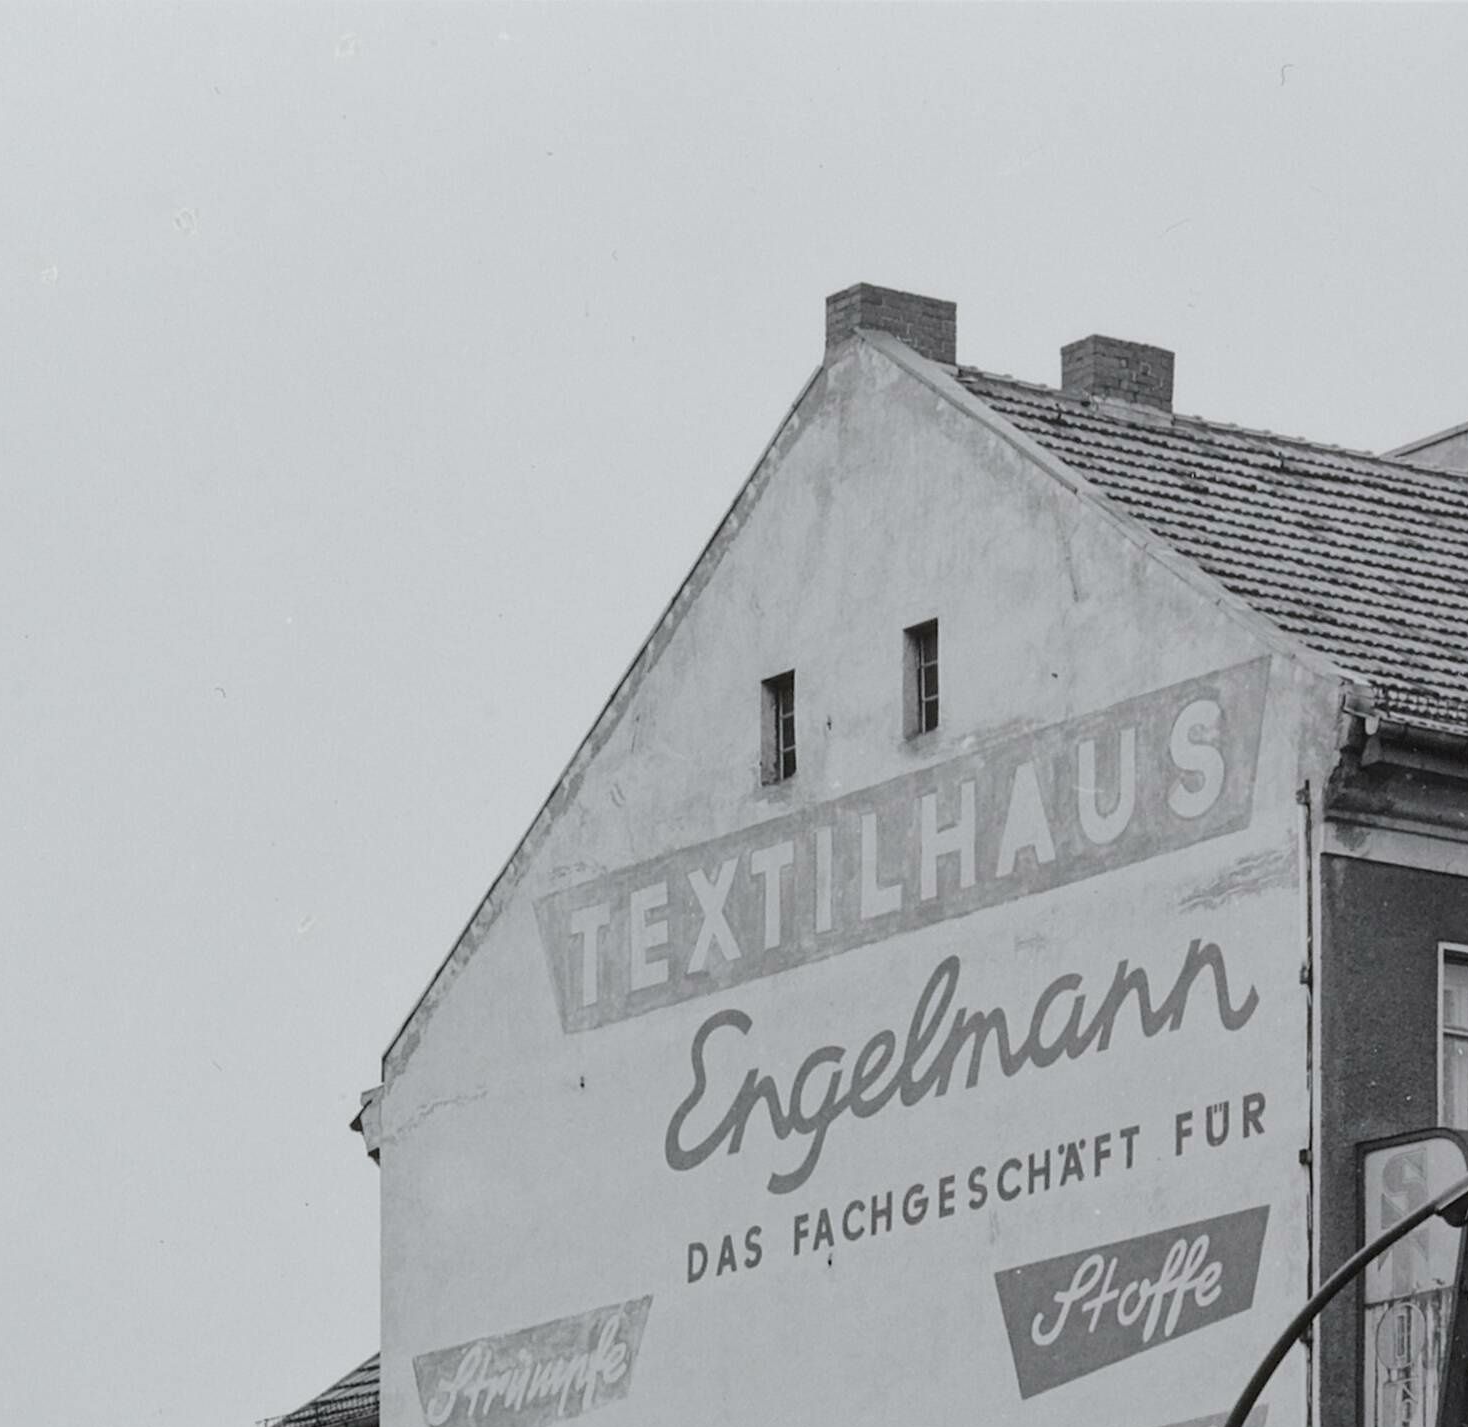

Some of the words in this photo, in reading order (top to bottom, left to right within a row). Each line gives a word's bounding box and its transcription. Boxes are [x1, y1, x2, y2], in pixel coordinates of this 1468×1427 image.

[569, 698, 1226, 1008] TEXTILHAUS
[665, 937, 1260, 1196] Engelmann
[687, 1225, 764, 1284] DAS
[793, 1126, 1141, 1259] FACHGESCHÄFT
[1174, 1091, 1267, 1157] FÜR
[427, 1314, 628, 1427] Strümpfe
[1031, 1233, 1223, 1343] Stoffe
